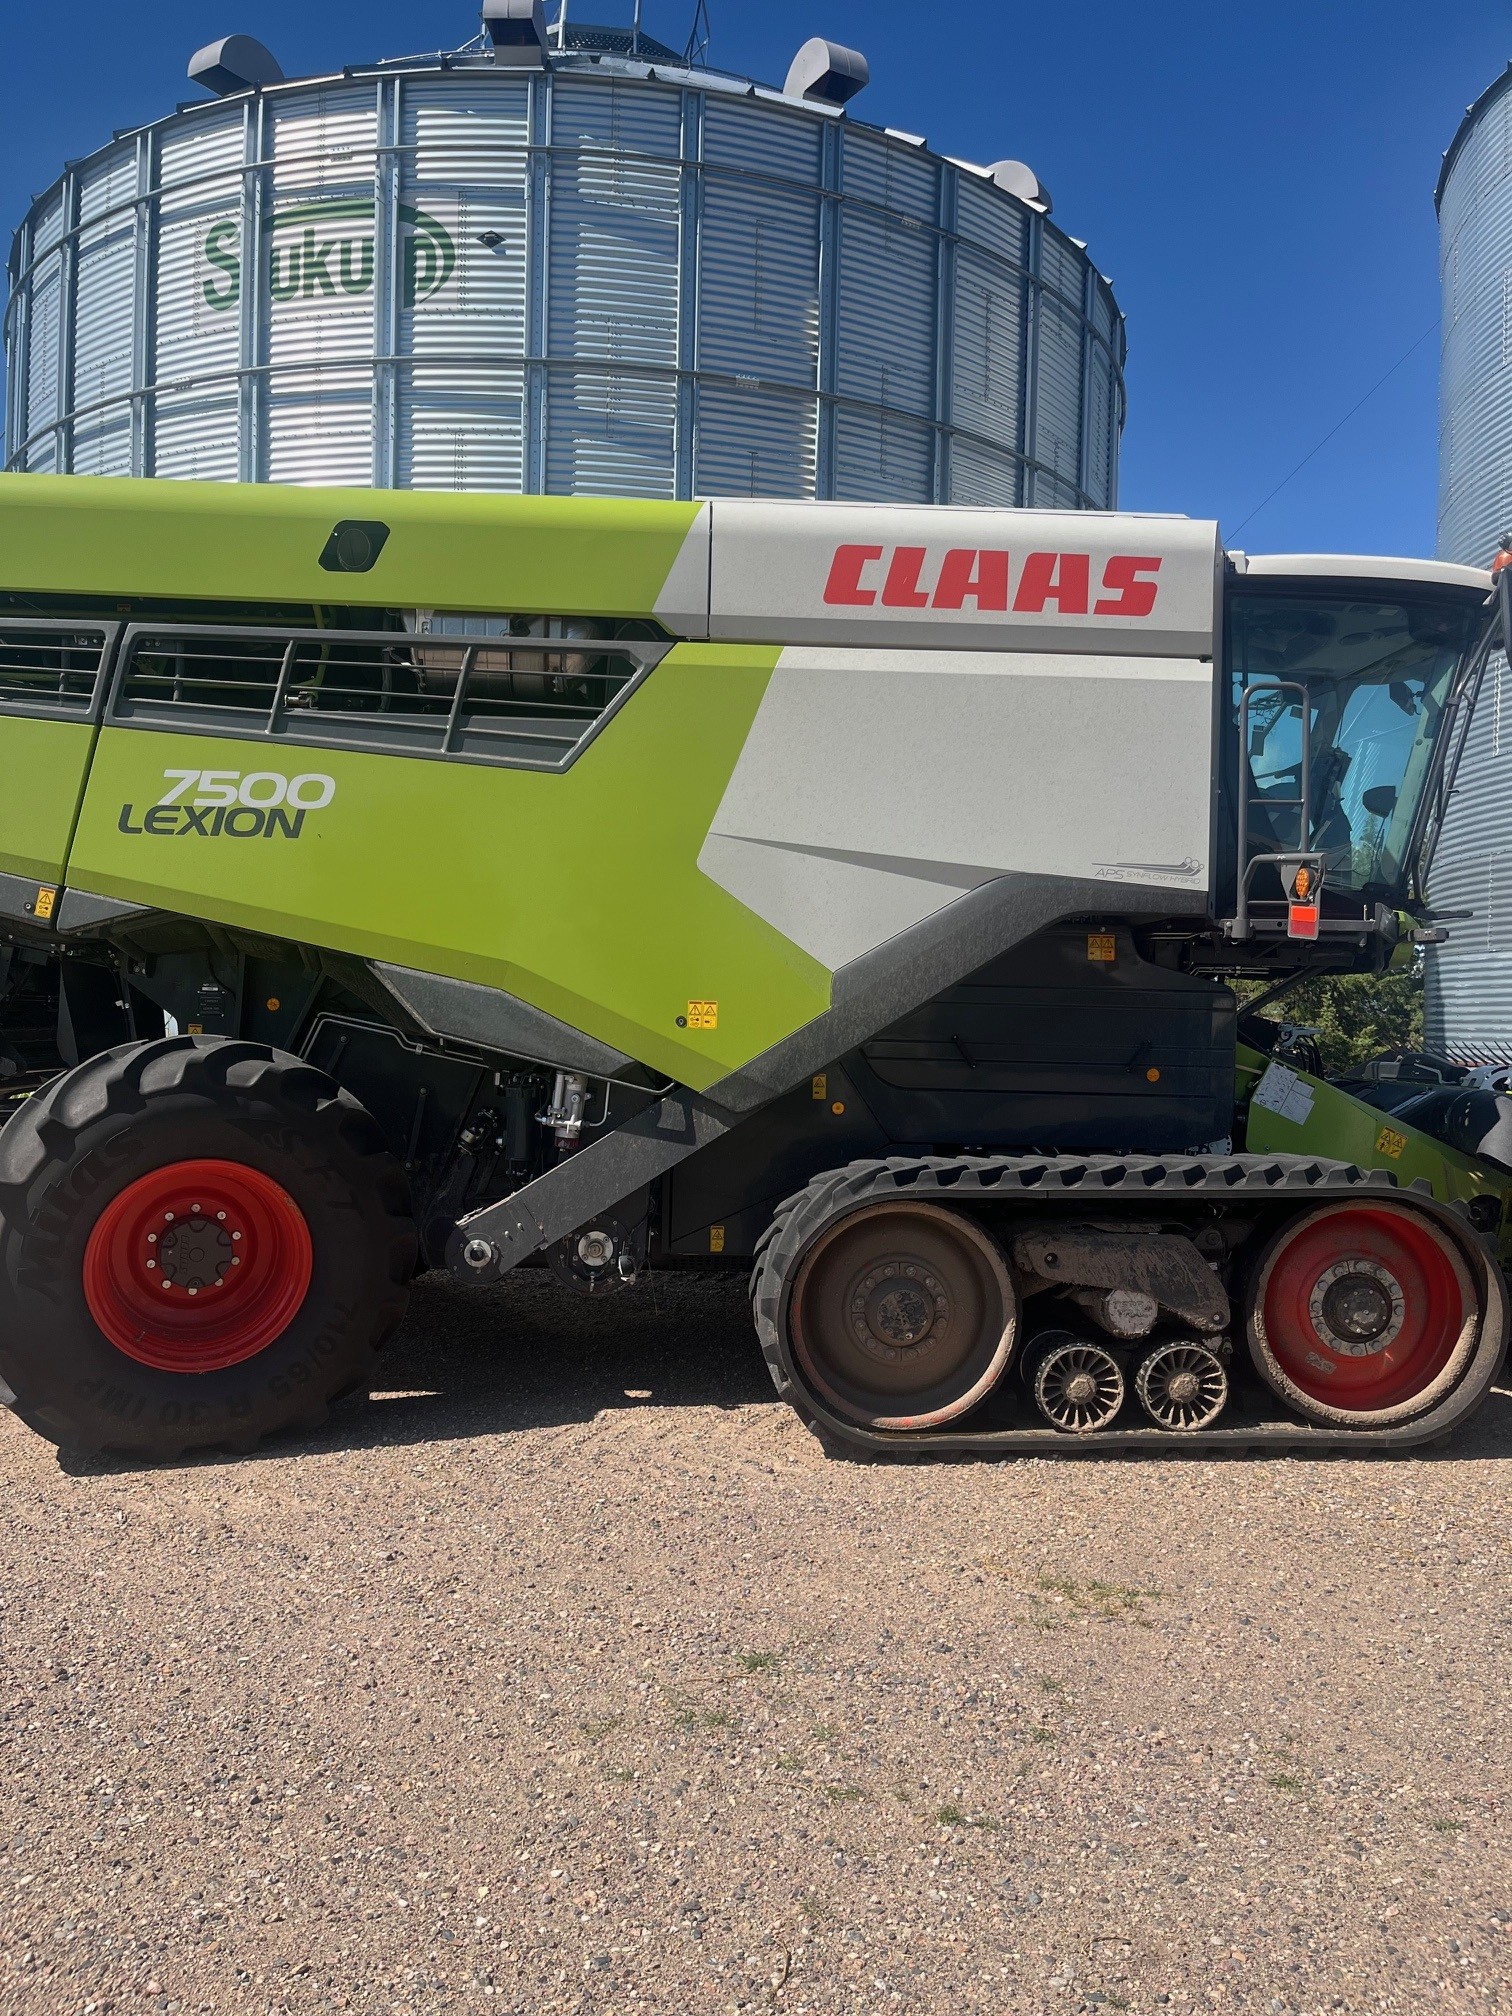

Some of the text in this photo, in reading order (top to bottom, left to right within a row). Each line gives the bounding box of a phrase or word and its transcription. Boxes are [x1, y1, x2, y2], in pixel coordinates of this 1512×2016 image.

[823, 544, 1163, 617] CLAAS
[157, 769, 336, 810] 7500
[117, 804, 307, 839] LEXION
[1094, 868, 1201, 885] APS SYNFLOW HYBRID
